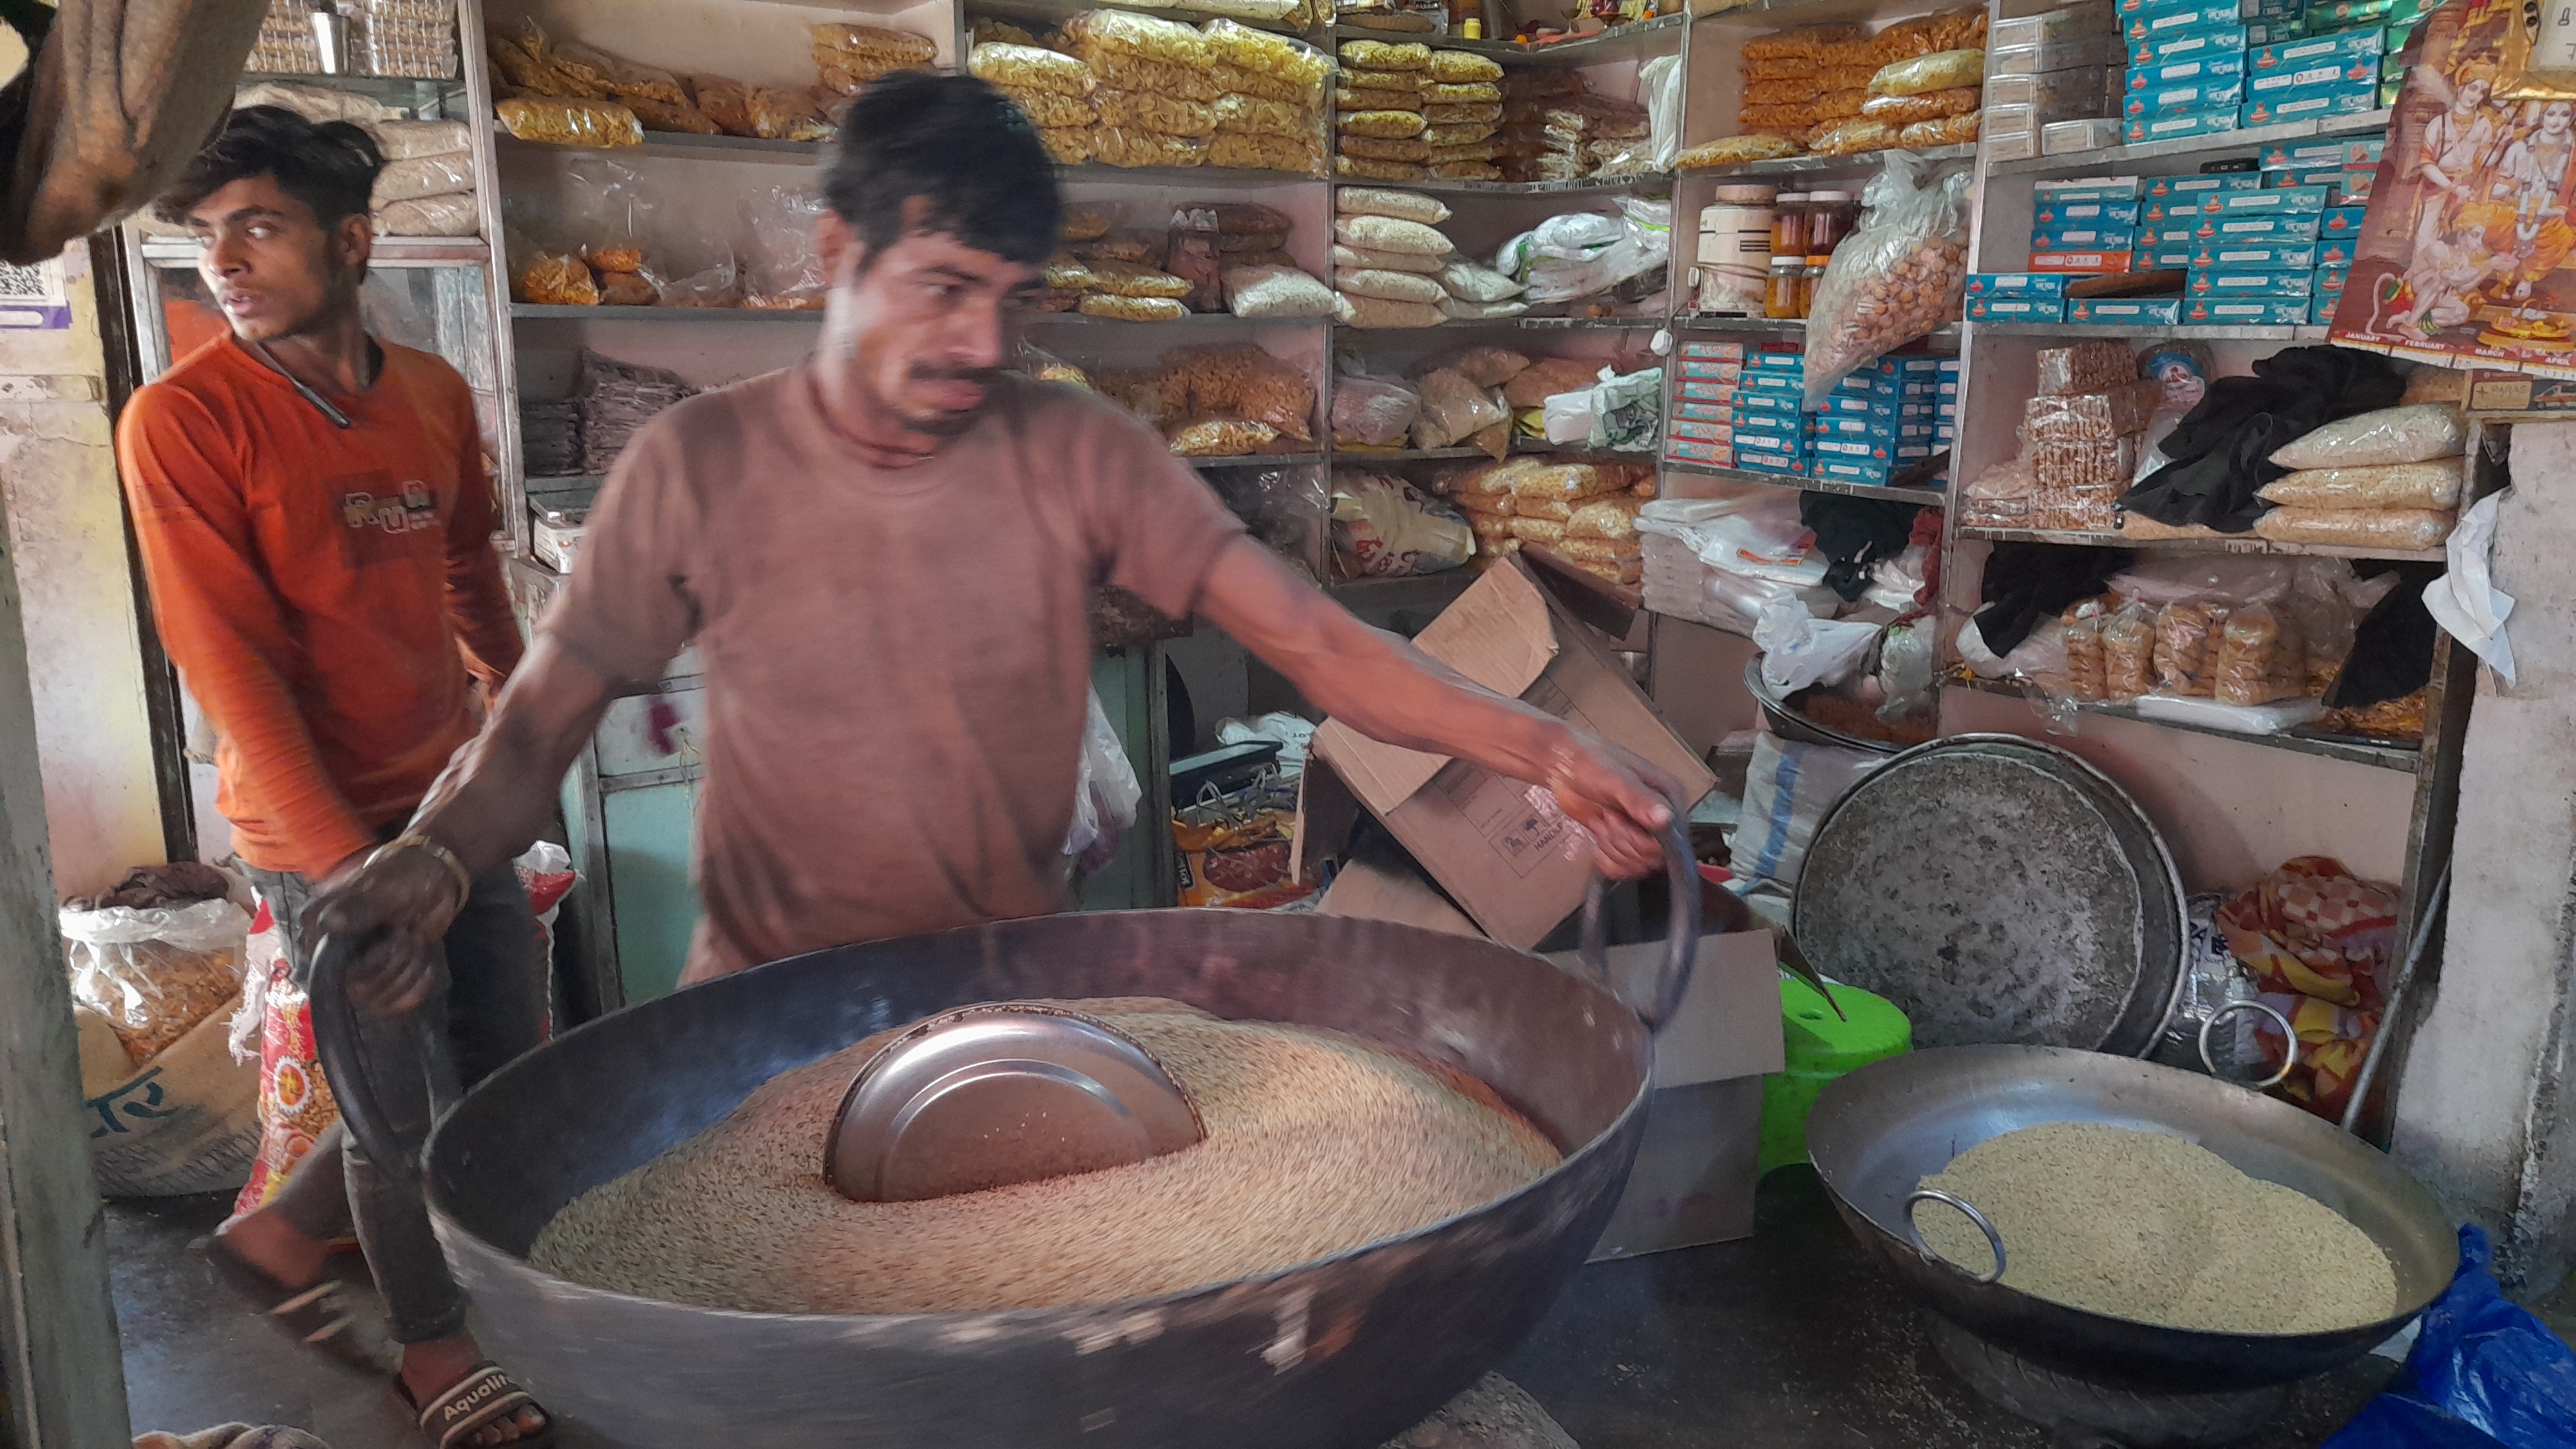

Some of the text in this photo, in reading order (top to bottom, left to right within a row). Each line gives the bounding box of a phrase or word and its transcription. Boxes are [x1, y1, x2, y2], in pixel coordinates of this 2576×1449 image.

[2345, 332, 2382, 342] JANUARY
[2405, 339, 2445, 350] FEBRUARY
[2474, 348, 2505, 357] MARCH
[2544, 357, 2571, 366] APRIL
